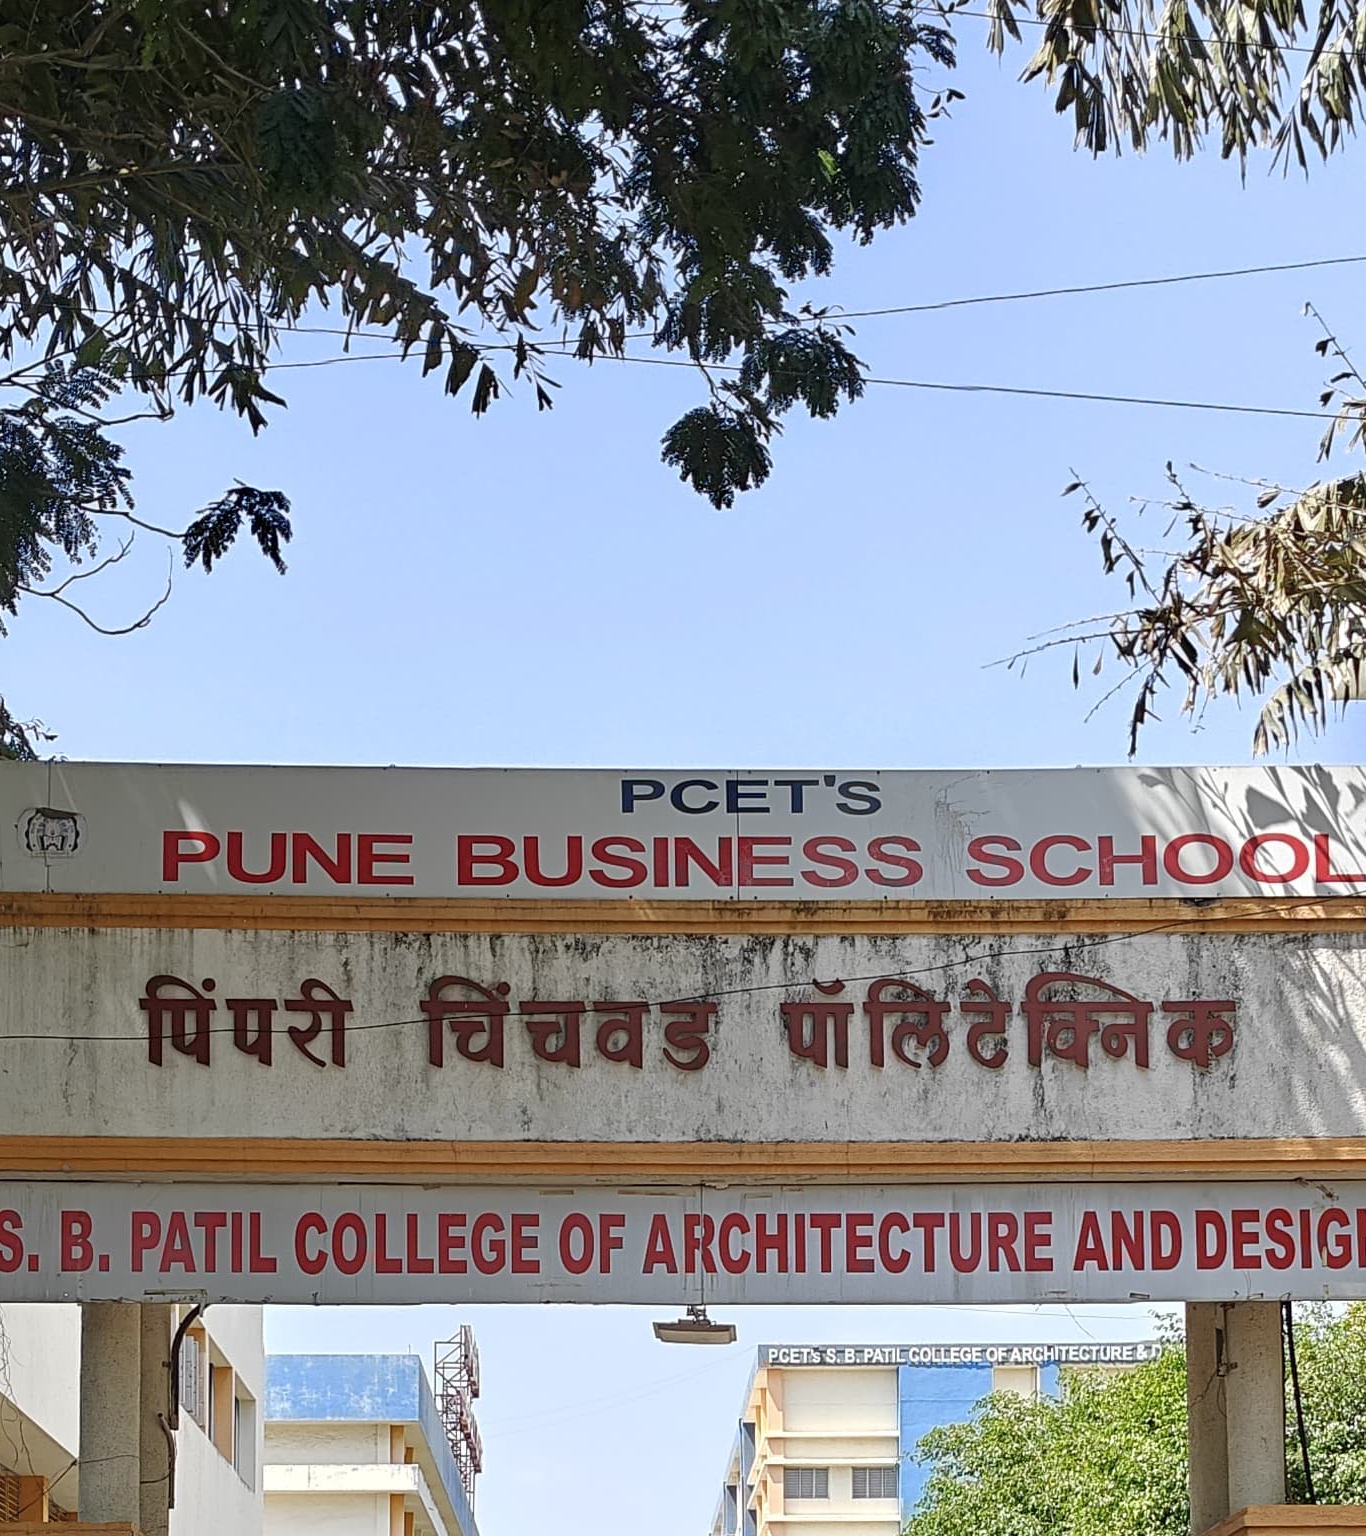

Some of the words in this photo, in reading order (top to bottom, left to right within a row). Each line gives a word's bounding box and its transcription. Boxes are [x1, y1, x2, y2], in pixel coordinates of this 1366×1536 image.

[620, 777, 883, 816] PCET'S
[162, 830, 415, 886] PUNE
[456, 834, 924, 889] BUSINESS
[139, 974, 354, 1068] पिंपरी
[420, 975, 719, 1071] चिंचवड
[779, 971, 1237, 1070] पॉलिटेक्निक
[60, 1210, 111, 1273] B.
[131, 1210, 278, 1274] PATIL
[293, 1211, 541, 1275] COLLEGE
[557, 1212, 627, 1275] OF
[641, 1212, 1055, 1275] ARCHITECTURE
[1073, 1209, 1184, 1272] AND
[768, 1348, 821, 1364] PCET's
[825, 1348, 841, 1364] S.
[844, 1348, 860, 1364] B.
[863, 1348, 906, 1364] PATIL
[908, 1347, 983, 1363] COLLEGE
[986, 1346, 1010, 1362] OF
[1010, 1345, 1133, 1362] ARCHITECTURE
[1137, 1344, 1148, 1360] &
